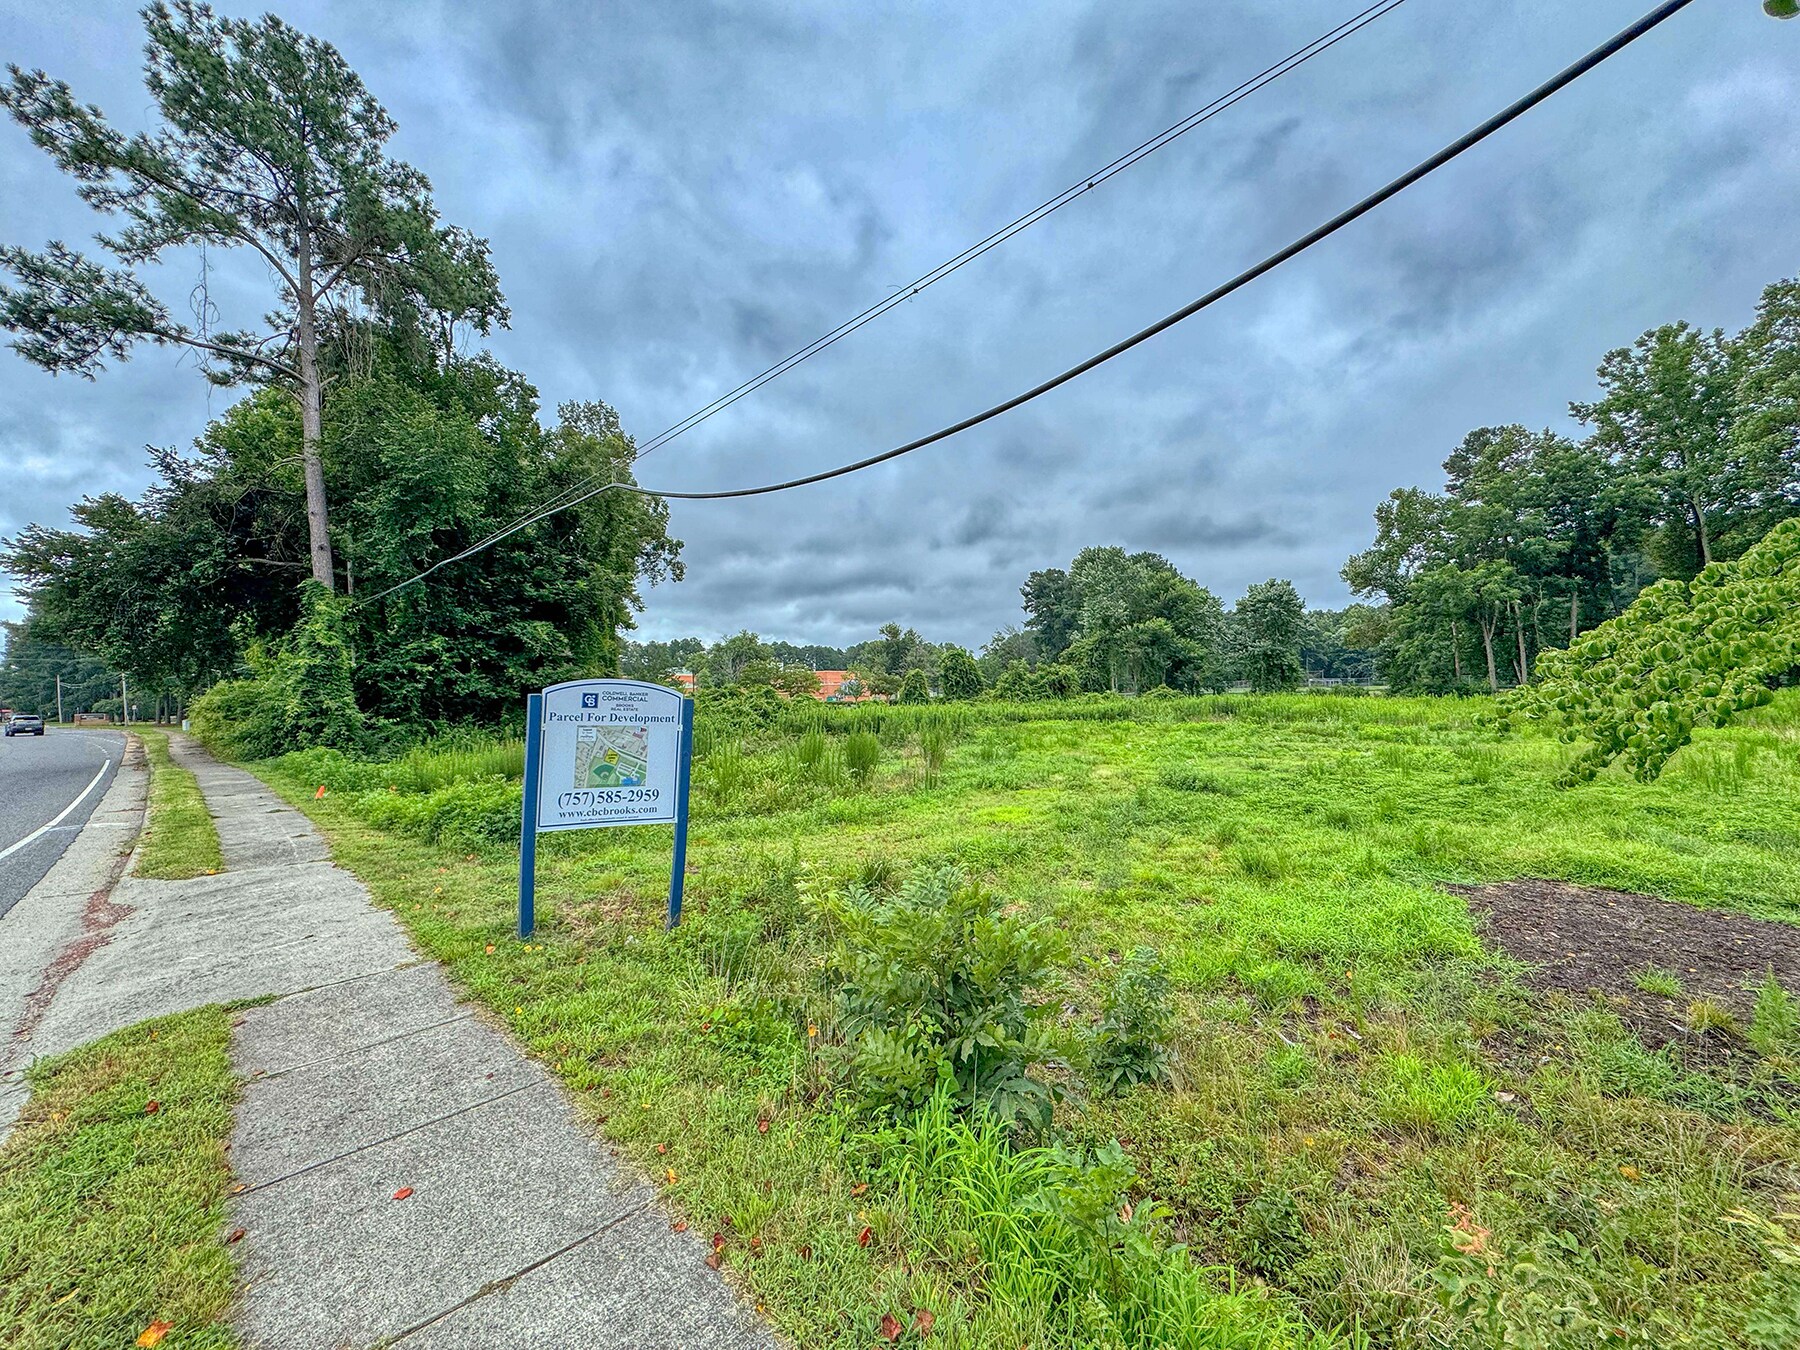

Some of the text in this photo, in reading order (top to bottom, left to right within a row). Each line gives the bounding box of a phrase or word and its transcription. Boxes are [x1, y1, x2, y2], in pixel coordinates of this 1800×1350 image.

[601, 695, 649, 703] COMMERCIAL
[549, 712, 675, 724] Parcel For Development
[558, 788, 660, 809] (757) 585-2959
[559, 806, 658, 818] www.cbcbrooks.com
